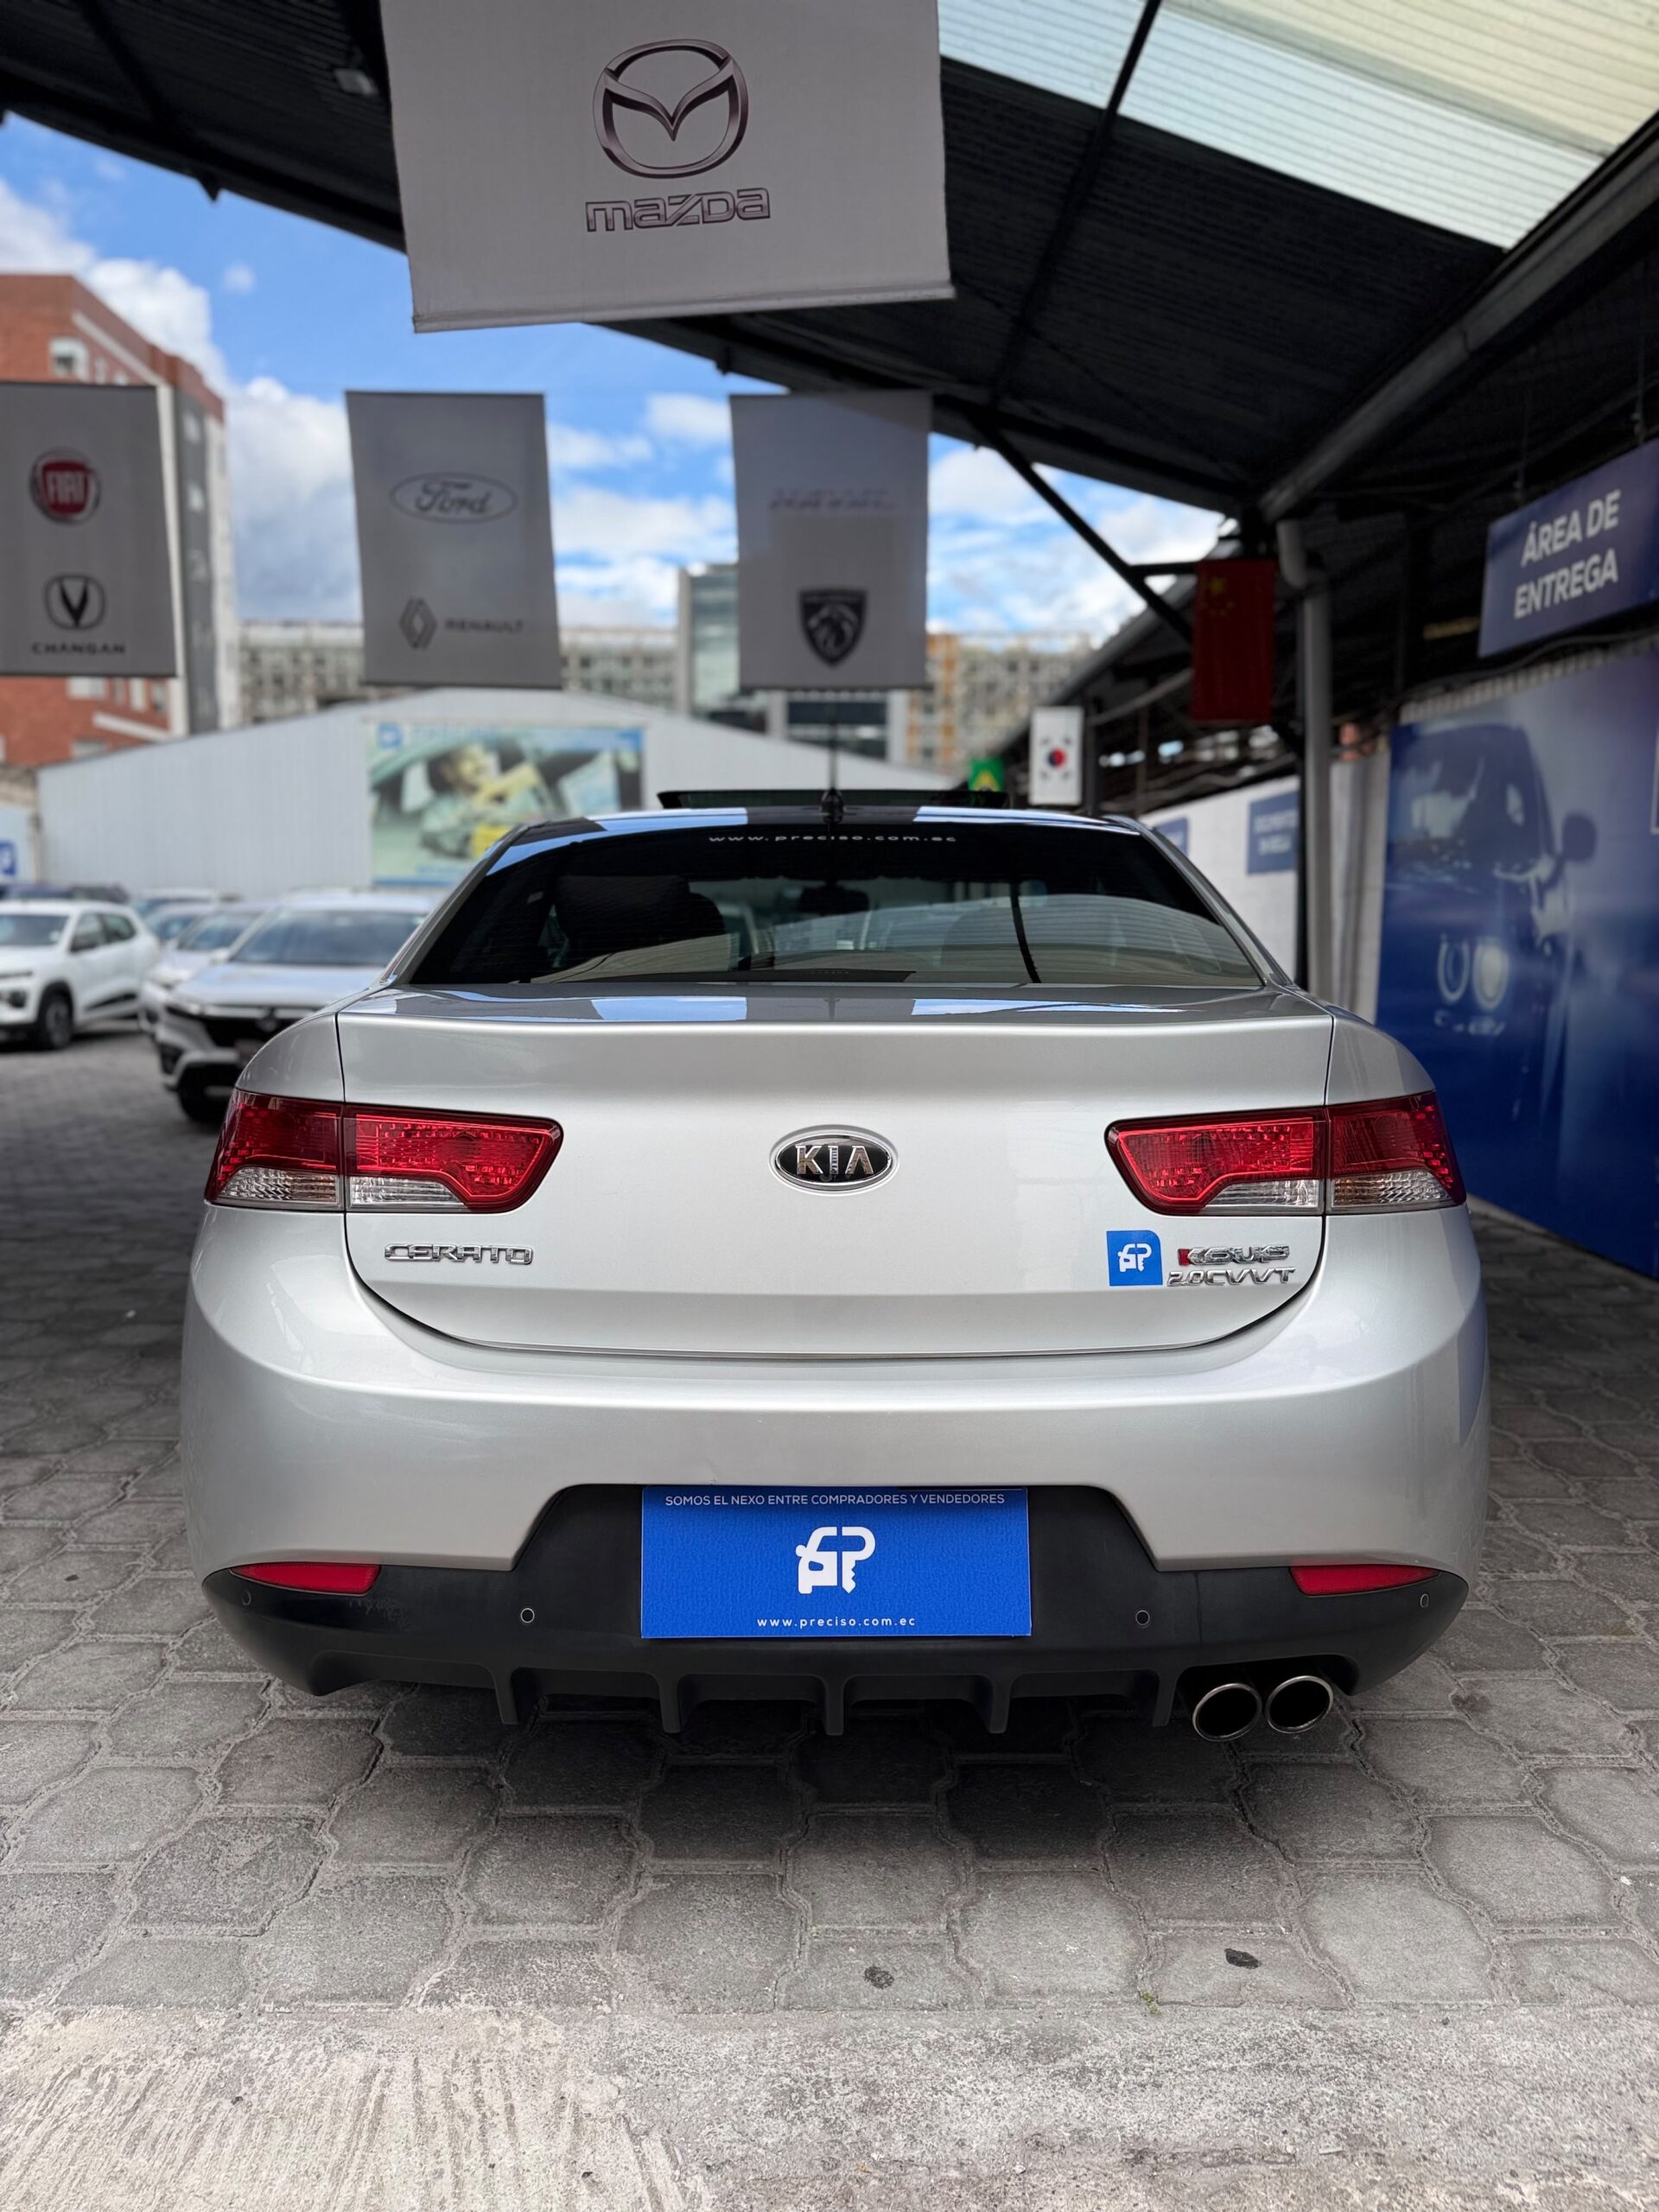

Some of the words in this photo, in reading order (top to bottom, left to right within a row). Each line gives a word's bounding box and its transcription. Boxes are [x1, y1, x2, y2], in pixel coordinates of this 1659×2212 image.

[46, 469, 85, 505] FIAT
[415, 480, 493, 514] Ford
[1520, 508, 1582, 568] ÁREA
[1586, 488, 1621, 539] DE
[1514, 547, 1619, 620] ENTREGA
[31, 641, 126, 656] CHANGAN
[795, 1145, 874, 1175] KIA
[385, 1243, 534, 1265] CERATO
[665, 1496, 710, 1506] SOMOS
[714, 1496, 728, 1506] EL
[731, 1495, 765, 1505] NEXO
[768, 1495, 808, 1505] ENTRE
[811, 1494, 907, 1505] COMPRADORES
[910, 1494, 918, 1504] Y
[919, 1493, 1005, 1504] VENDEDORES
[757, 1617, 916, 1629] www.preciso.com.ec
